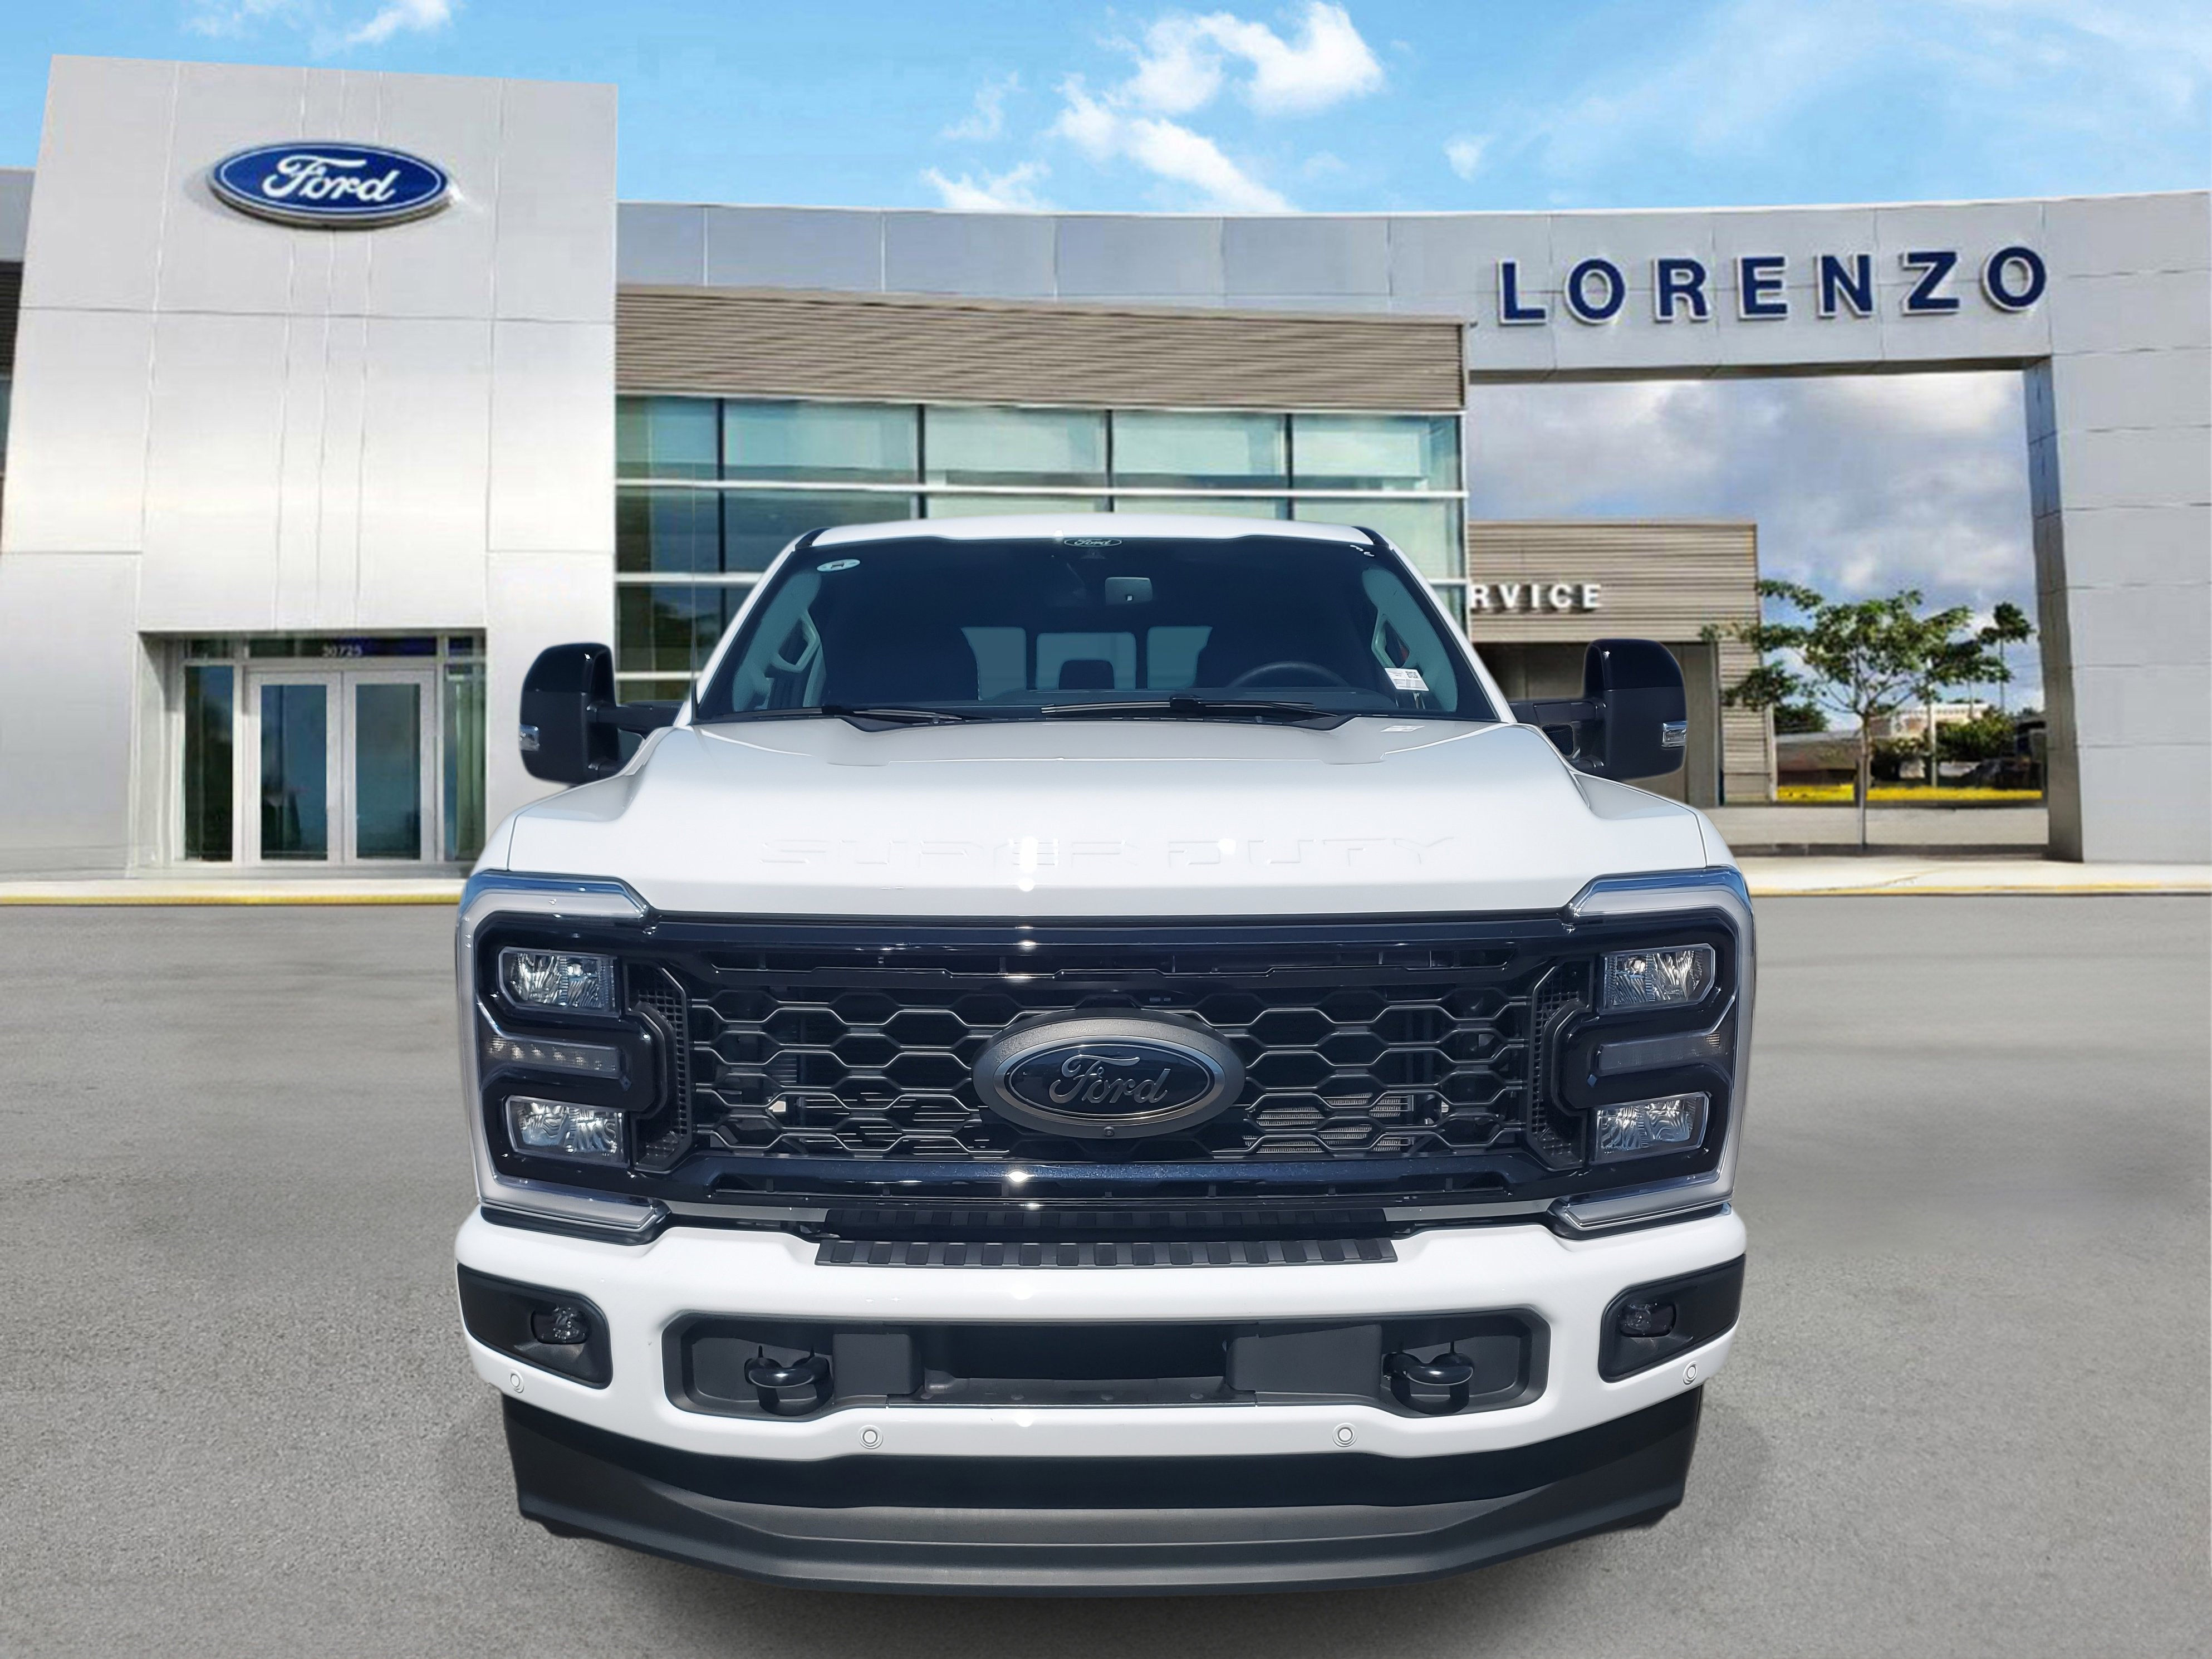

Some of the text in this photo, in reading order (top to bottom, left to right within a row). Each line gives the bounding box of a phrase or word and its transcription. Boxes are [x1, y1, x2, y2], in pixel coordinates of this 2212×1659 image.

[262, 154, 400, 202] Ford
[1498, 246, 2047, 324] LORENZO
[758, 836, 1455, 868] SUPER DUTY
[1049, 1054, 1171, 1104] Ford
